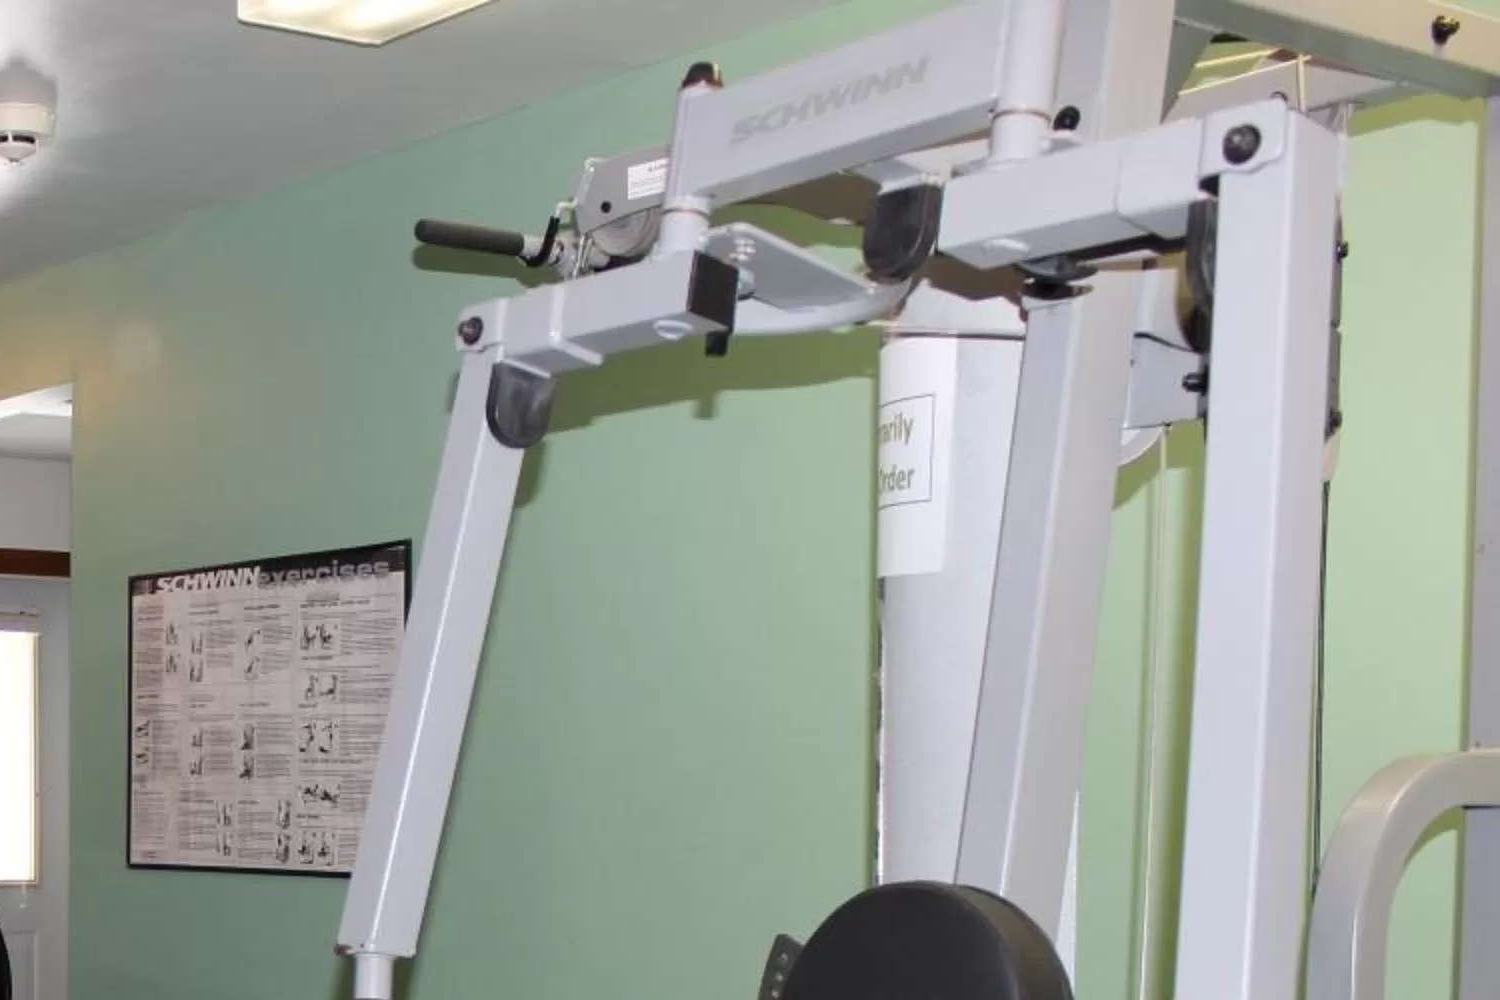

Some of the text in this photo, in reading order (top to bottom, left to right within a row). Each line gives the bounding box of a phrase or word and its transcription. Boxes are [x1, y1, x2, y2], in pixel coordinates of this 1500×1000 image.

[730, 57, 931, 146] SCHWINN
[156, 560, 389, 593] SCHWINN exercises
